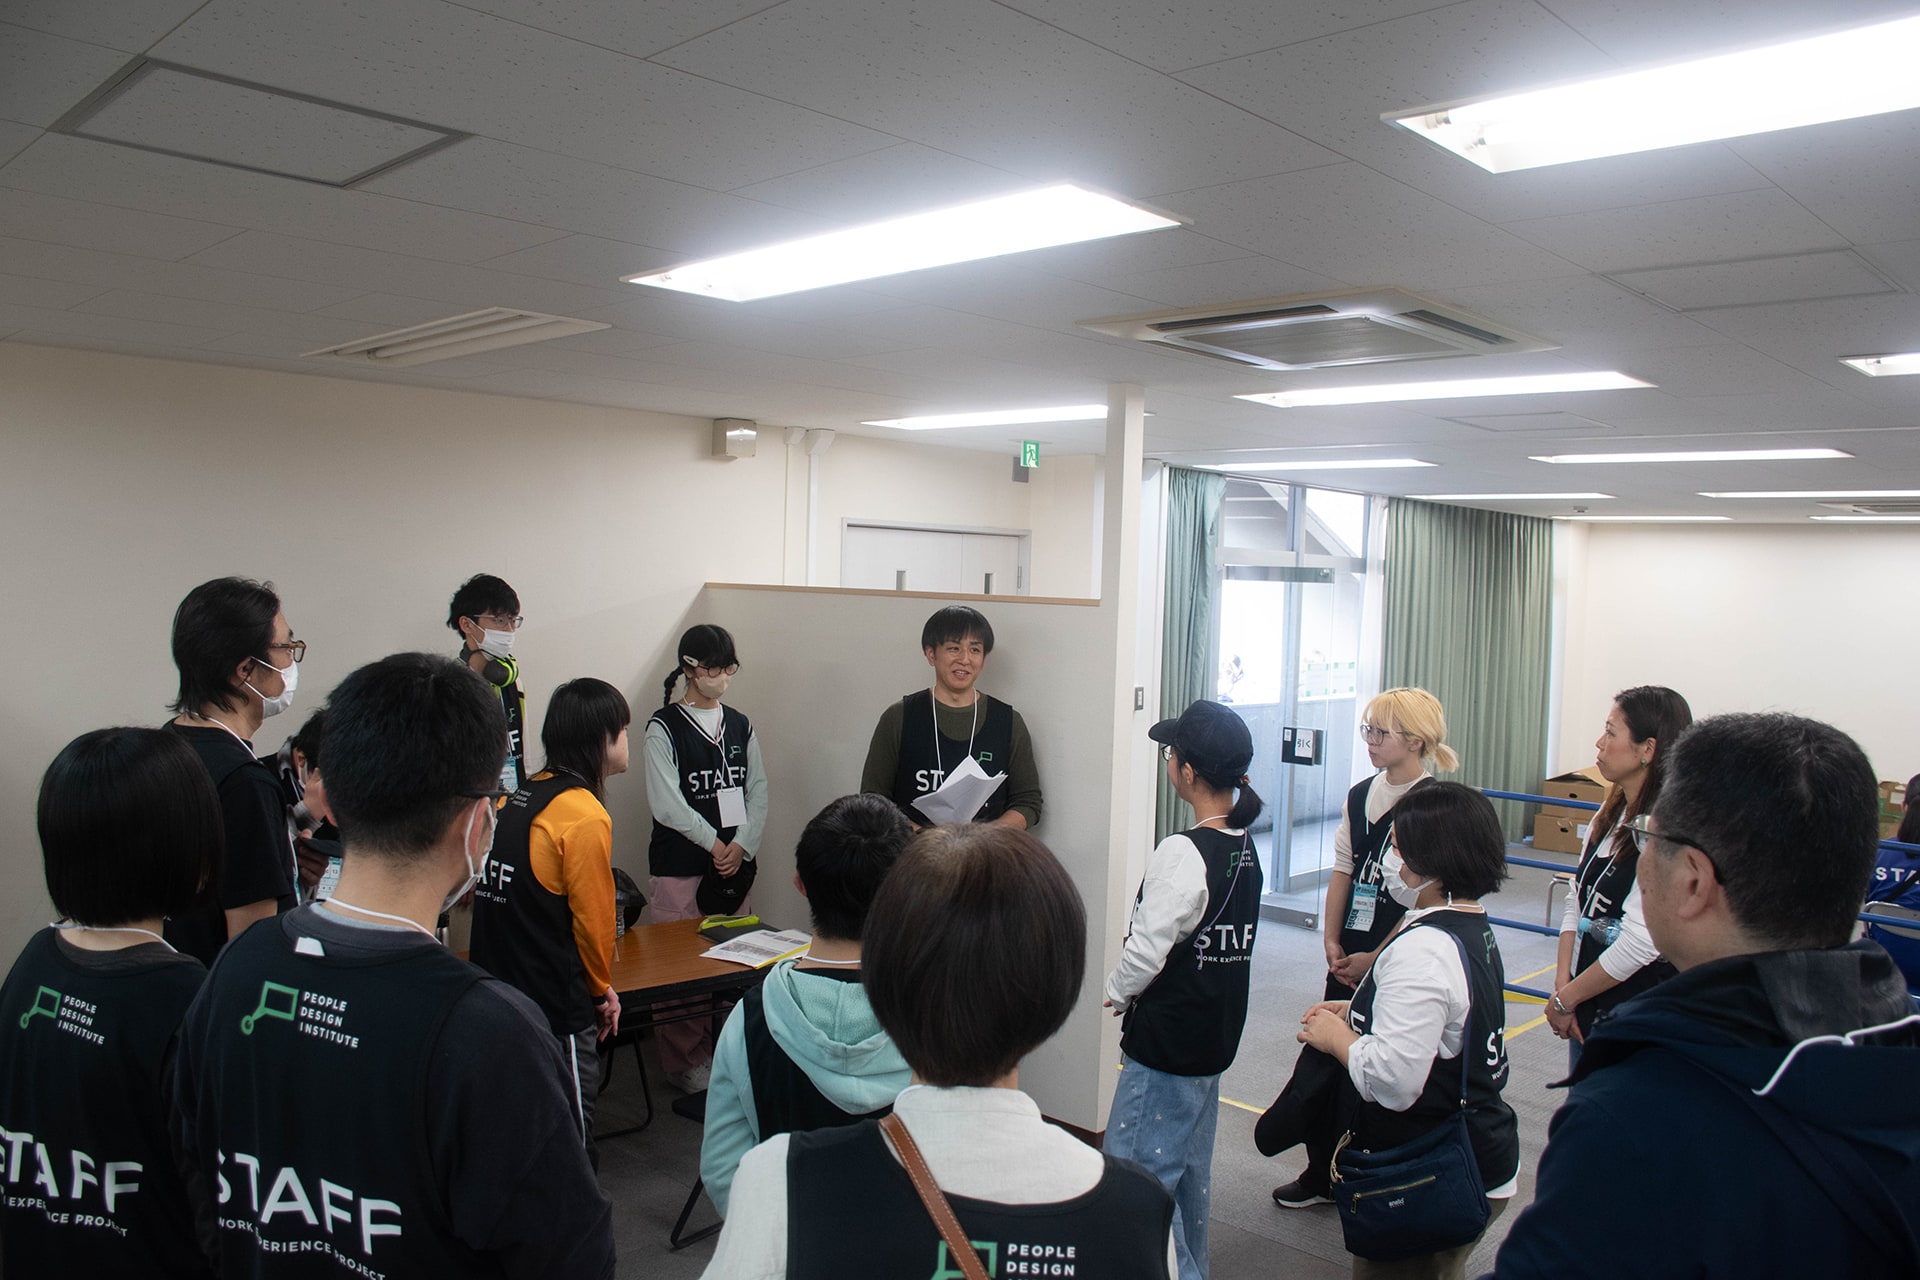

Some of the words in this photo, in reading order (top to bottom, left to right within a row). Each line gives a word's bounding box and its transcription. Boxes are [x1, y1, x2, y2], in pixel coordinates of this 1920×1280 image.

[687, 765, 747, 793] STAFF
[914, 769, 945, 792] ST
[64, 994, 97, 1014] PEOPLE
[302, 990, 348, 1012] PEOPLE
[60, 1007, 94, 1027] DESIGN
[299, 1005, 343, 1027] DESIGN
[58, 1019, 105, 1045] INSTITUTE
[299, 1021, 360, 1048] INSTITUTE
[1486, 1026, 1505, 1066] ST
[0, 1124, 144, 1214] TAFF
[1007, 1242, 1076, 1259] PEOPLE
[1006, 1260, 1075, 1277] DESIGN
